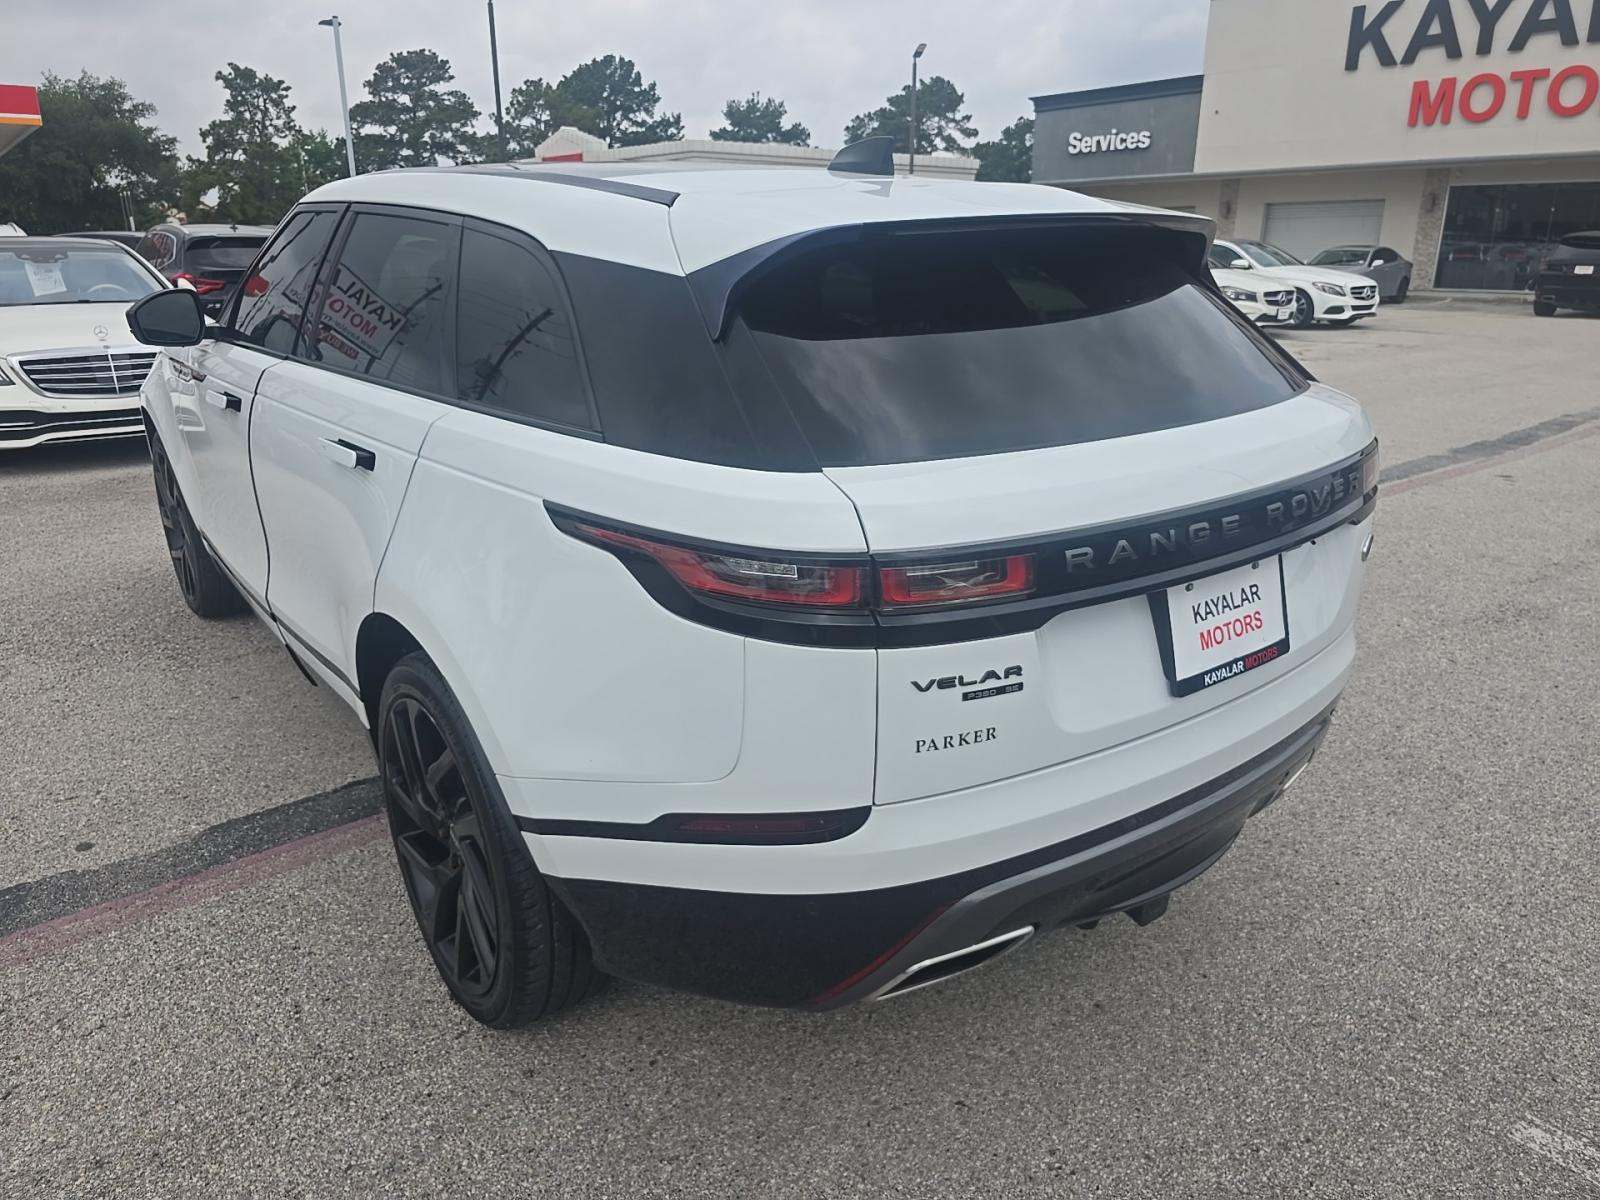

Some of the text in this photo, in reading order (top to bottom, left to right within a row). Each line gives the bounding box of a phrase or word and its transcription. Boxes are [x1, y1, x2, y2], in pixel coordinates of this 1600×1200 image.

[1407, 65, 1600, 128] MOTO
[1068, 128, 1151, 154] Services
[1065, 473, 1360, 573] RANGE ROVER
[1192, 583, 1262, 624] KAYALAR
[1199, 611, 1263, 651] MOTORS
[910, 665, 1023, 692] VELAR
[1204, 647, 1278, 686] KAYALAR MOTORS
[915, 727, 997, 754] PARKER
